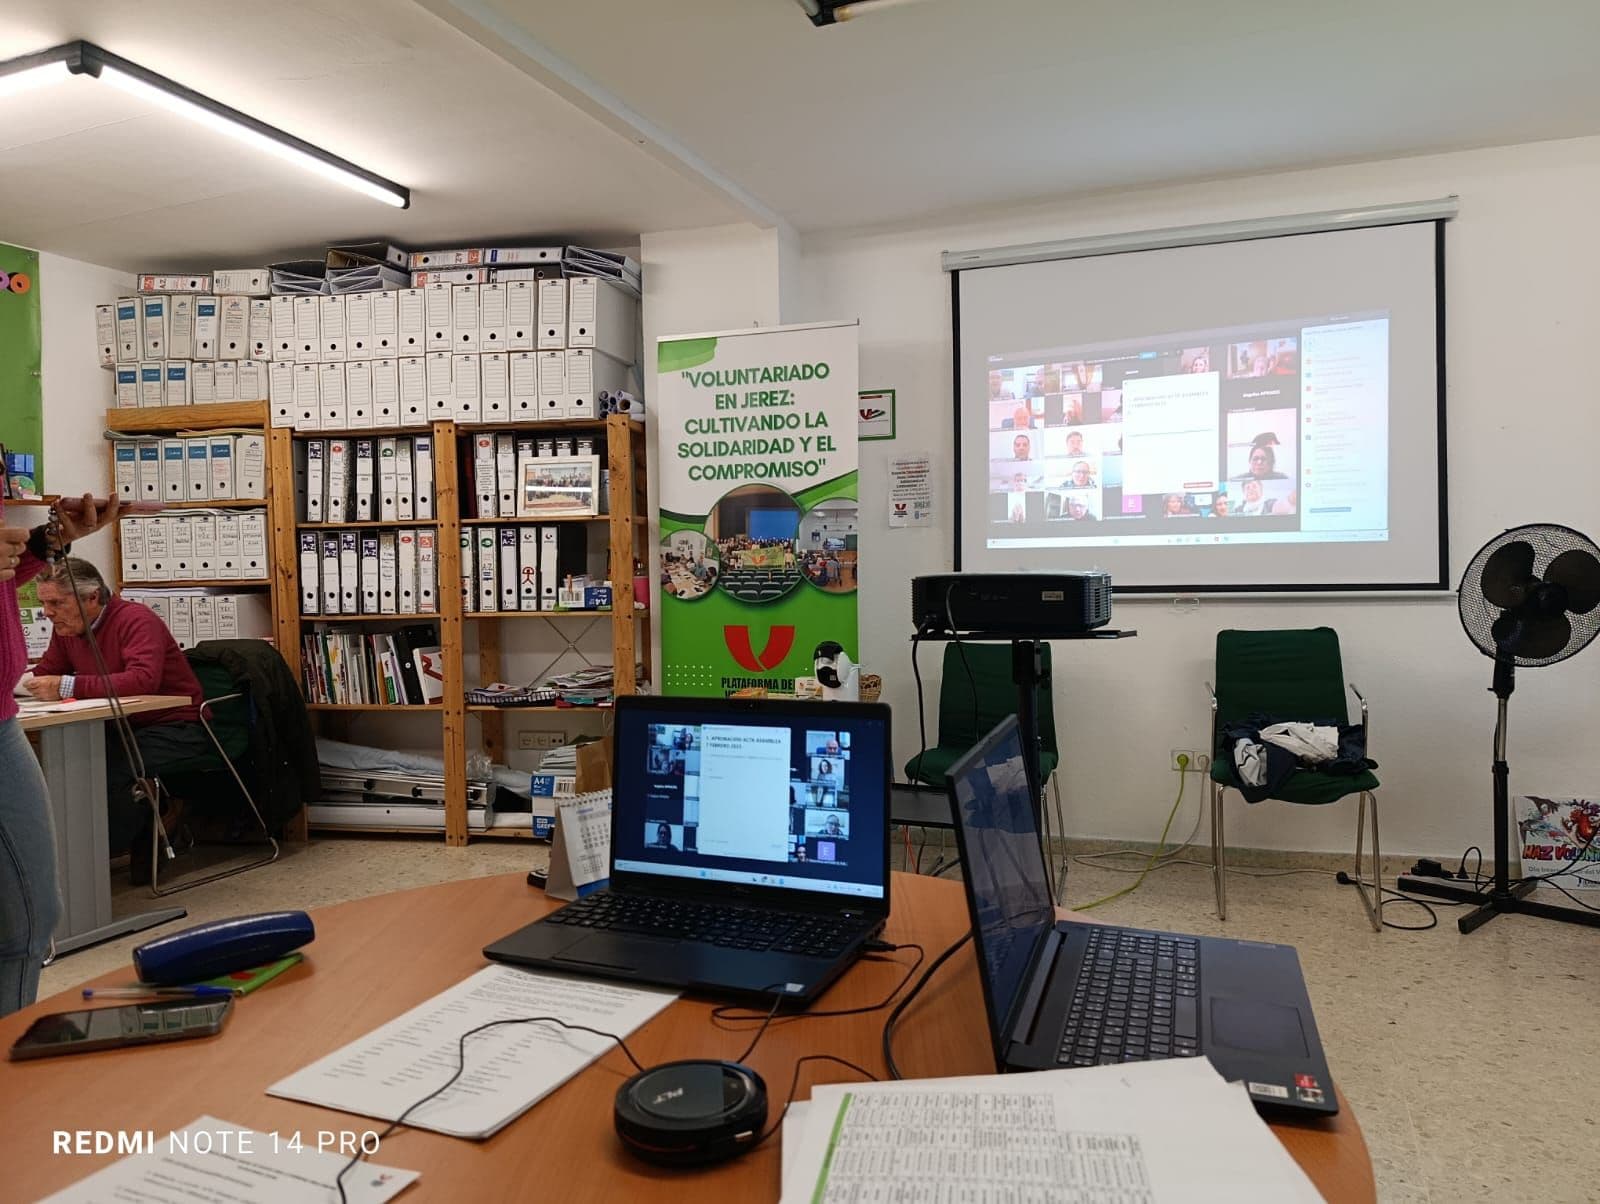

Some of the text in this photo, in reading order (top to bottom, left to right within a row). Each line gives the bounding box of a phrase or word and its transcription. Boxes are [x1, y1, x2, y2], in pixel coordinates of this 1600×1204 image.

[681, 363, 830, 388] "VOLUNTARIADO
[715, 391, 795, 410] EN JEREZ:
[684, 411, 828, 435] CULTIVANDO LA
[677, 436, 836, 459] SOLIDARIDAD Y EL
[688, 459, 826, 481] COMPROMISO"
[722, 677, 778, 690] PLATAFORMA
